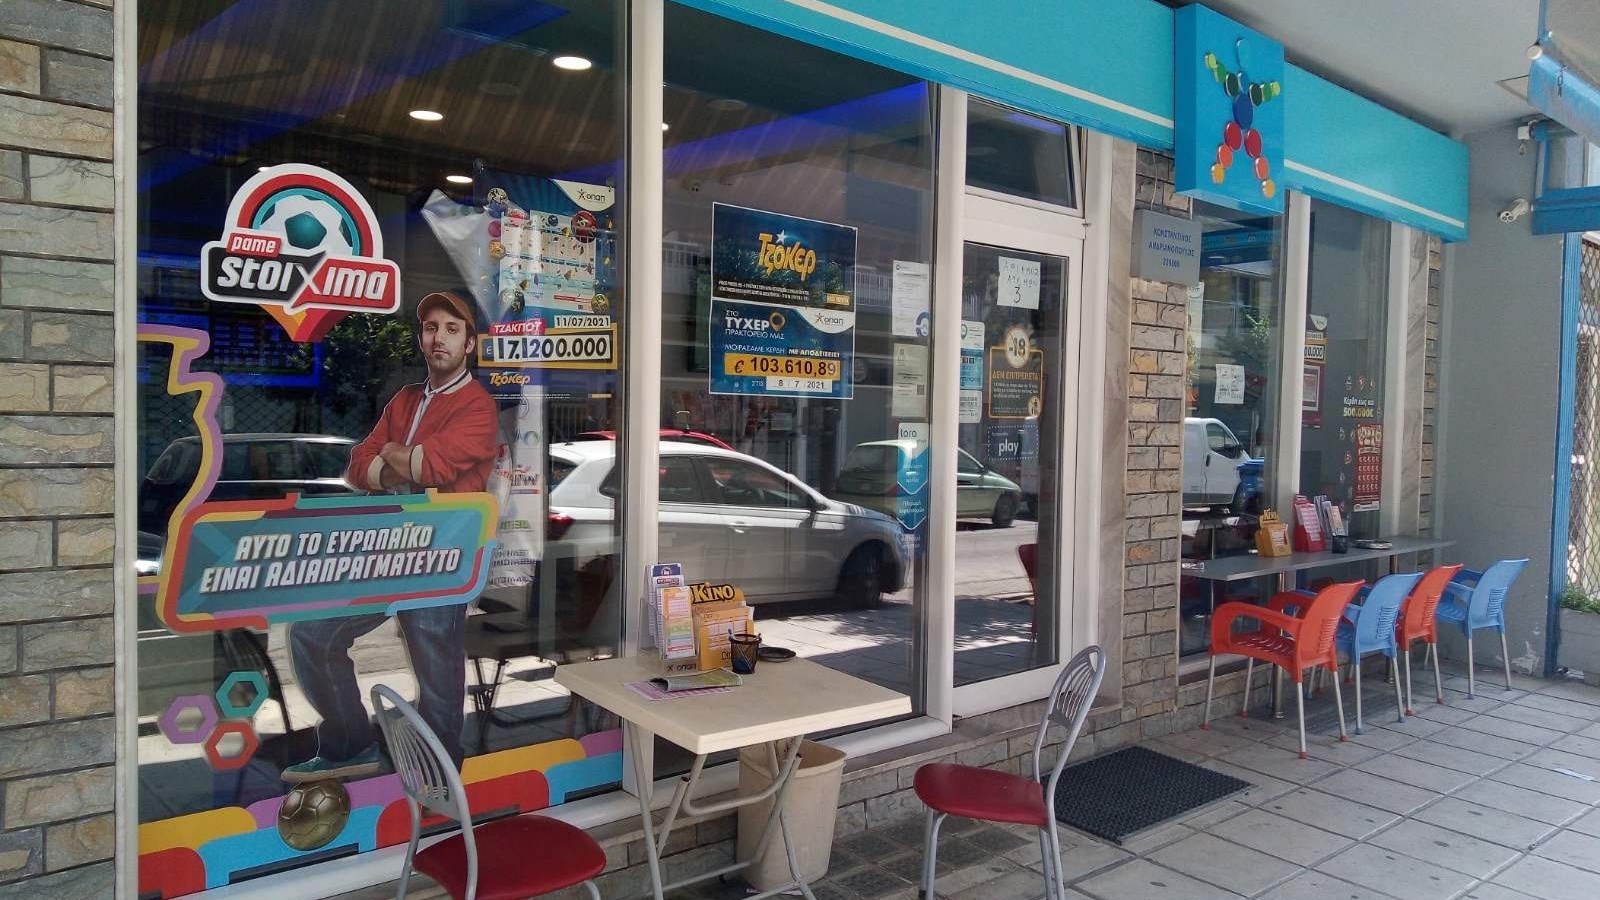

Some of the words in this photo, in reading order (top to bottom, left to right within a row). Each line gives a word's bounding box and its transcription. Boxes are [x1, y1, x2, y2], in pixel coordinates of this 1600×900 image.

[231, 235, 276, 253] pame
[1014, 286, 1021, 303] 3
[556, 316, 610, 327] 11/07/2021
[734, 360, 744, 373] €
[751, 357, 836, 377] 103.610,89
[998, 438, 1019, 456] play
[296, 532, 321, 556] ΤΟ
[200, 565, 259, 594] ΕΙΝΑΙ
[264, 549, 462, 588] ΑΔΙΑΠΡΑΓΜΑΤΕΥΤΟ
